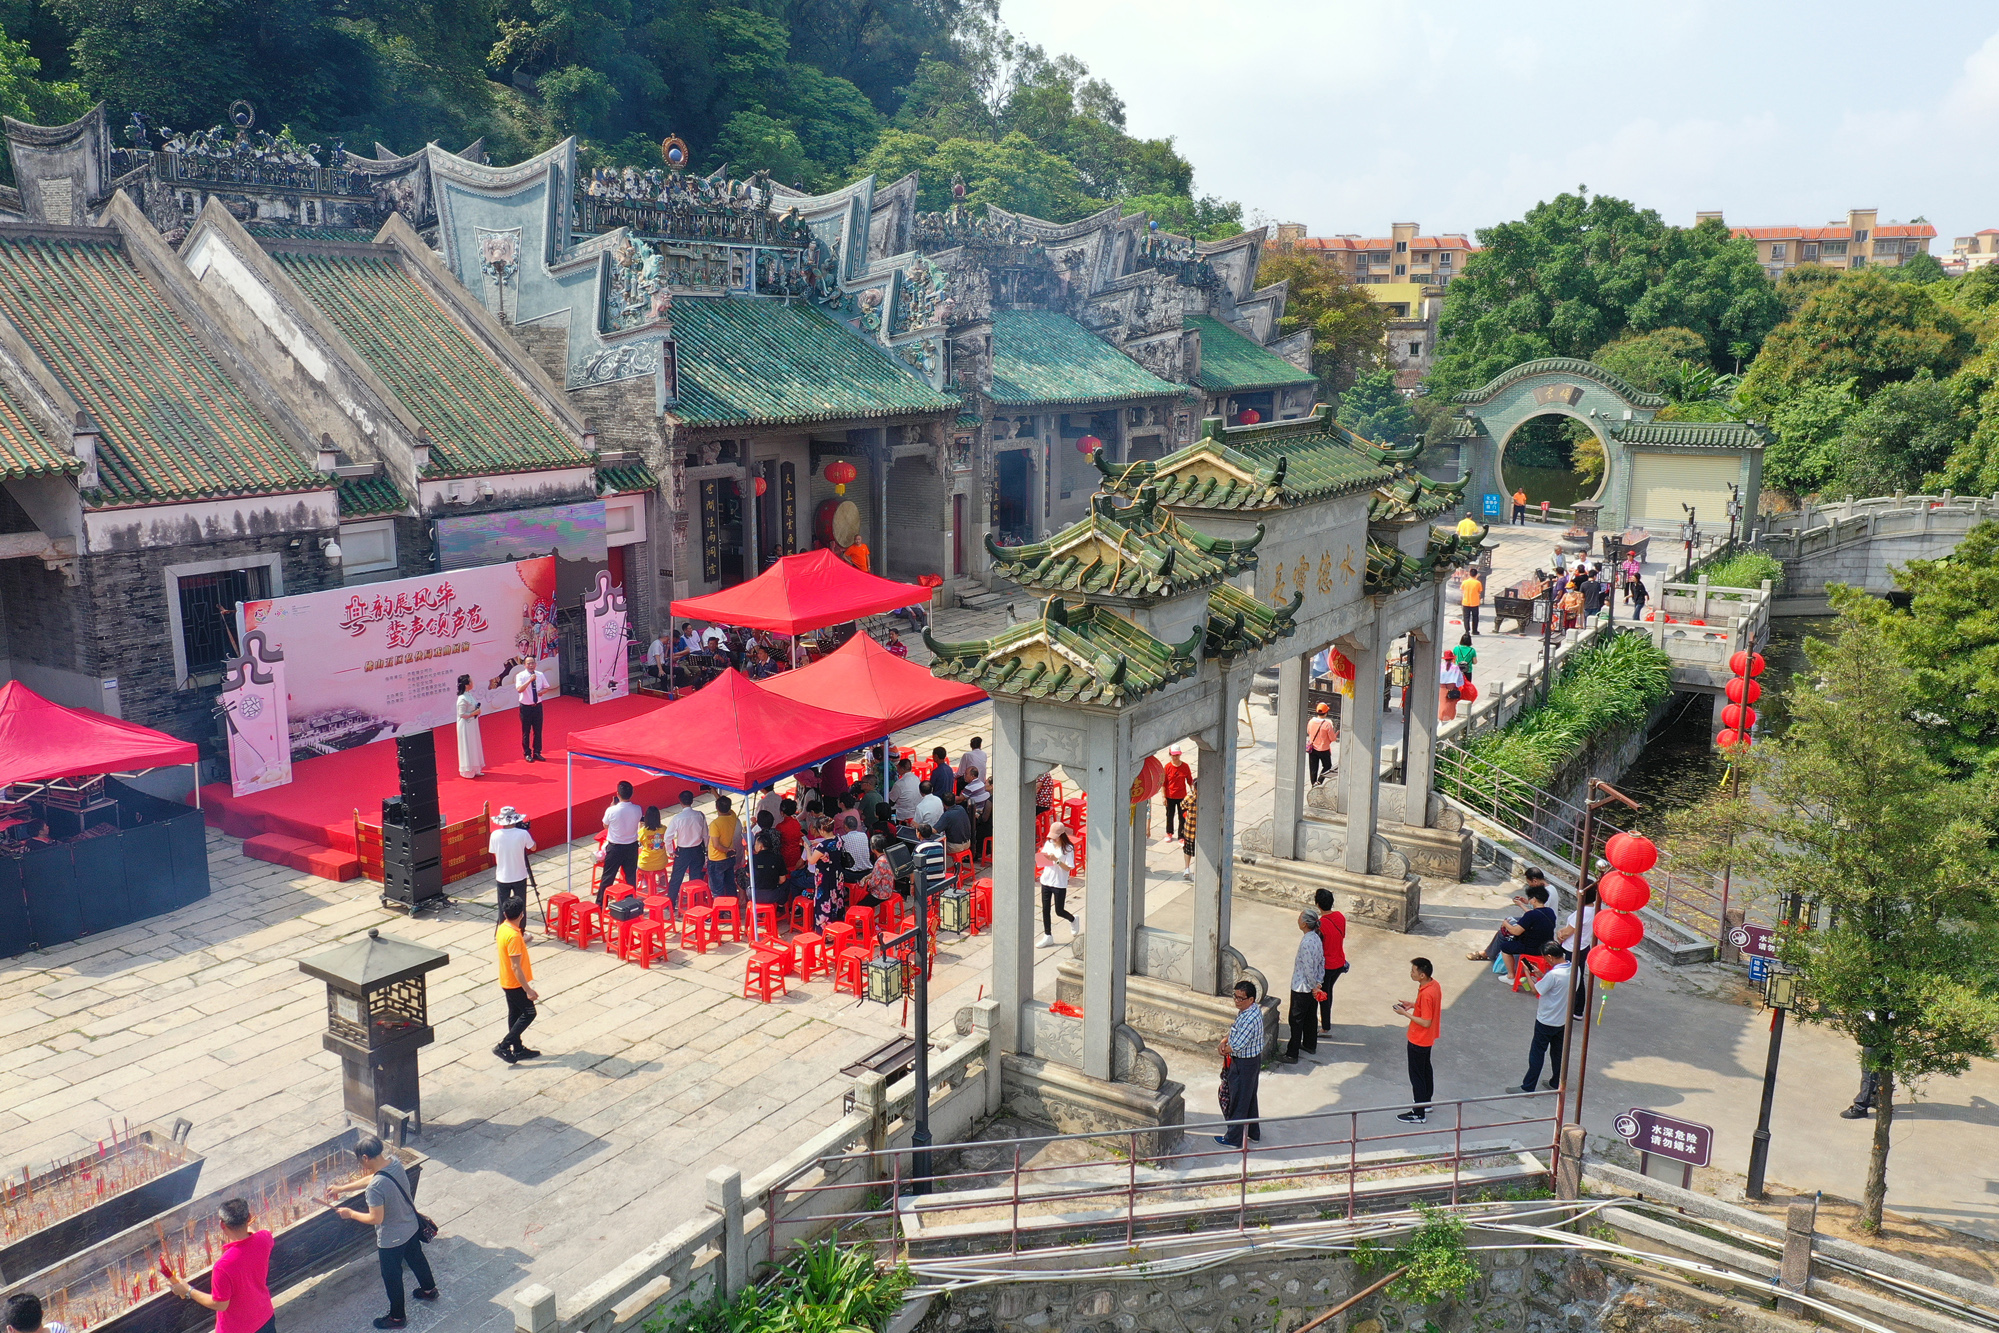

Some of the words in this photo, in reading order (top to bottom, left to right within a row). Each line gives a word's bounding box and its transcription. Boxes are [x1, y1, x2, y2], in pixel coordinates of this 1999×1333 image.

[339, 581, 456, 637] 粤韵展风华
[364, 641, 471, 673] 佛山五区私伙局戏曲展演
[1650, 1134, 1697, 1154] 请勿嬉水
[1651, 1124, 1698, 1144] 水深危险
